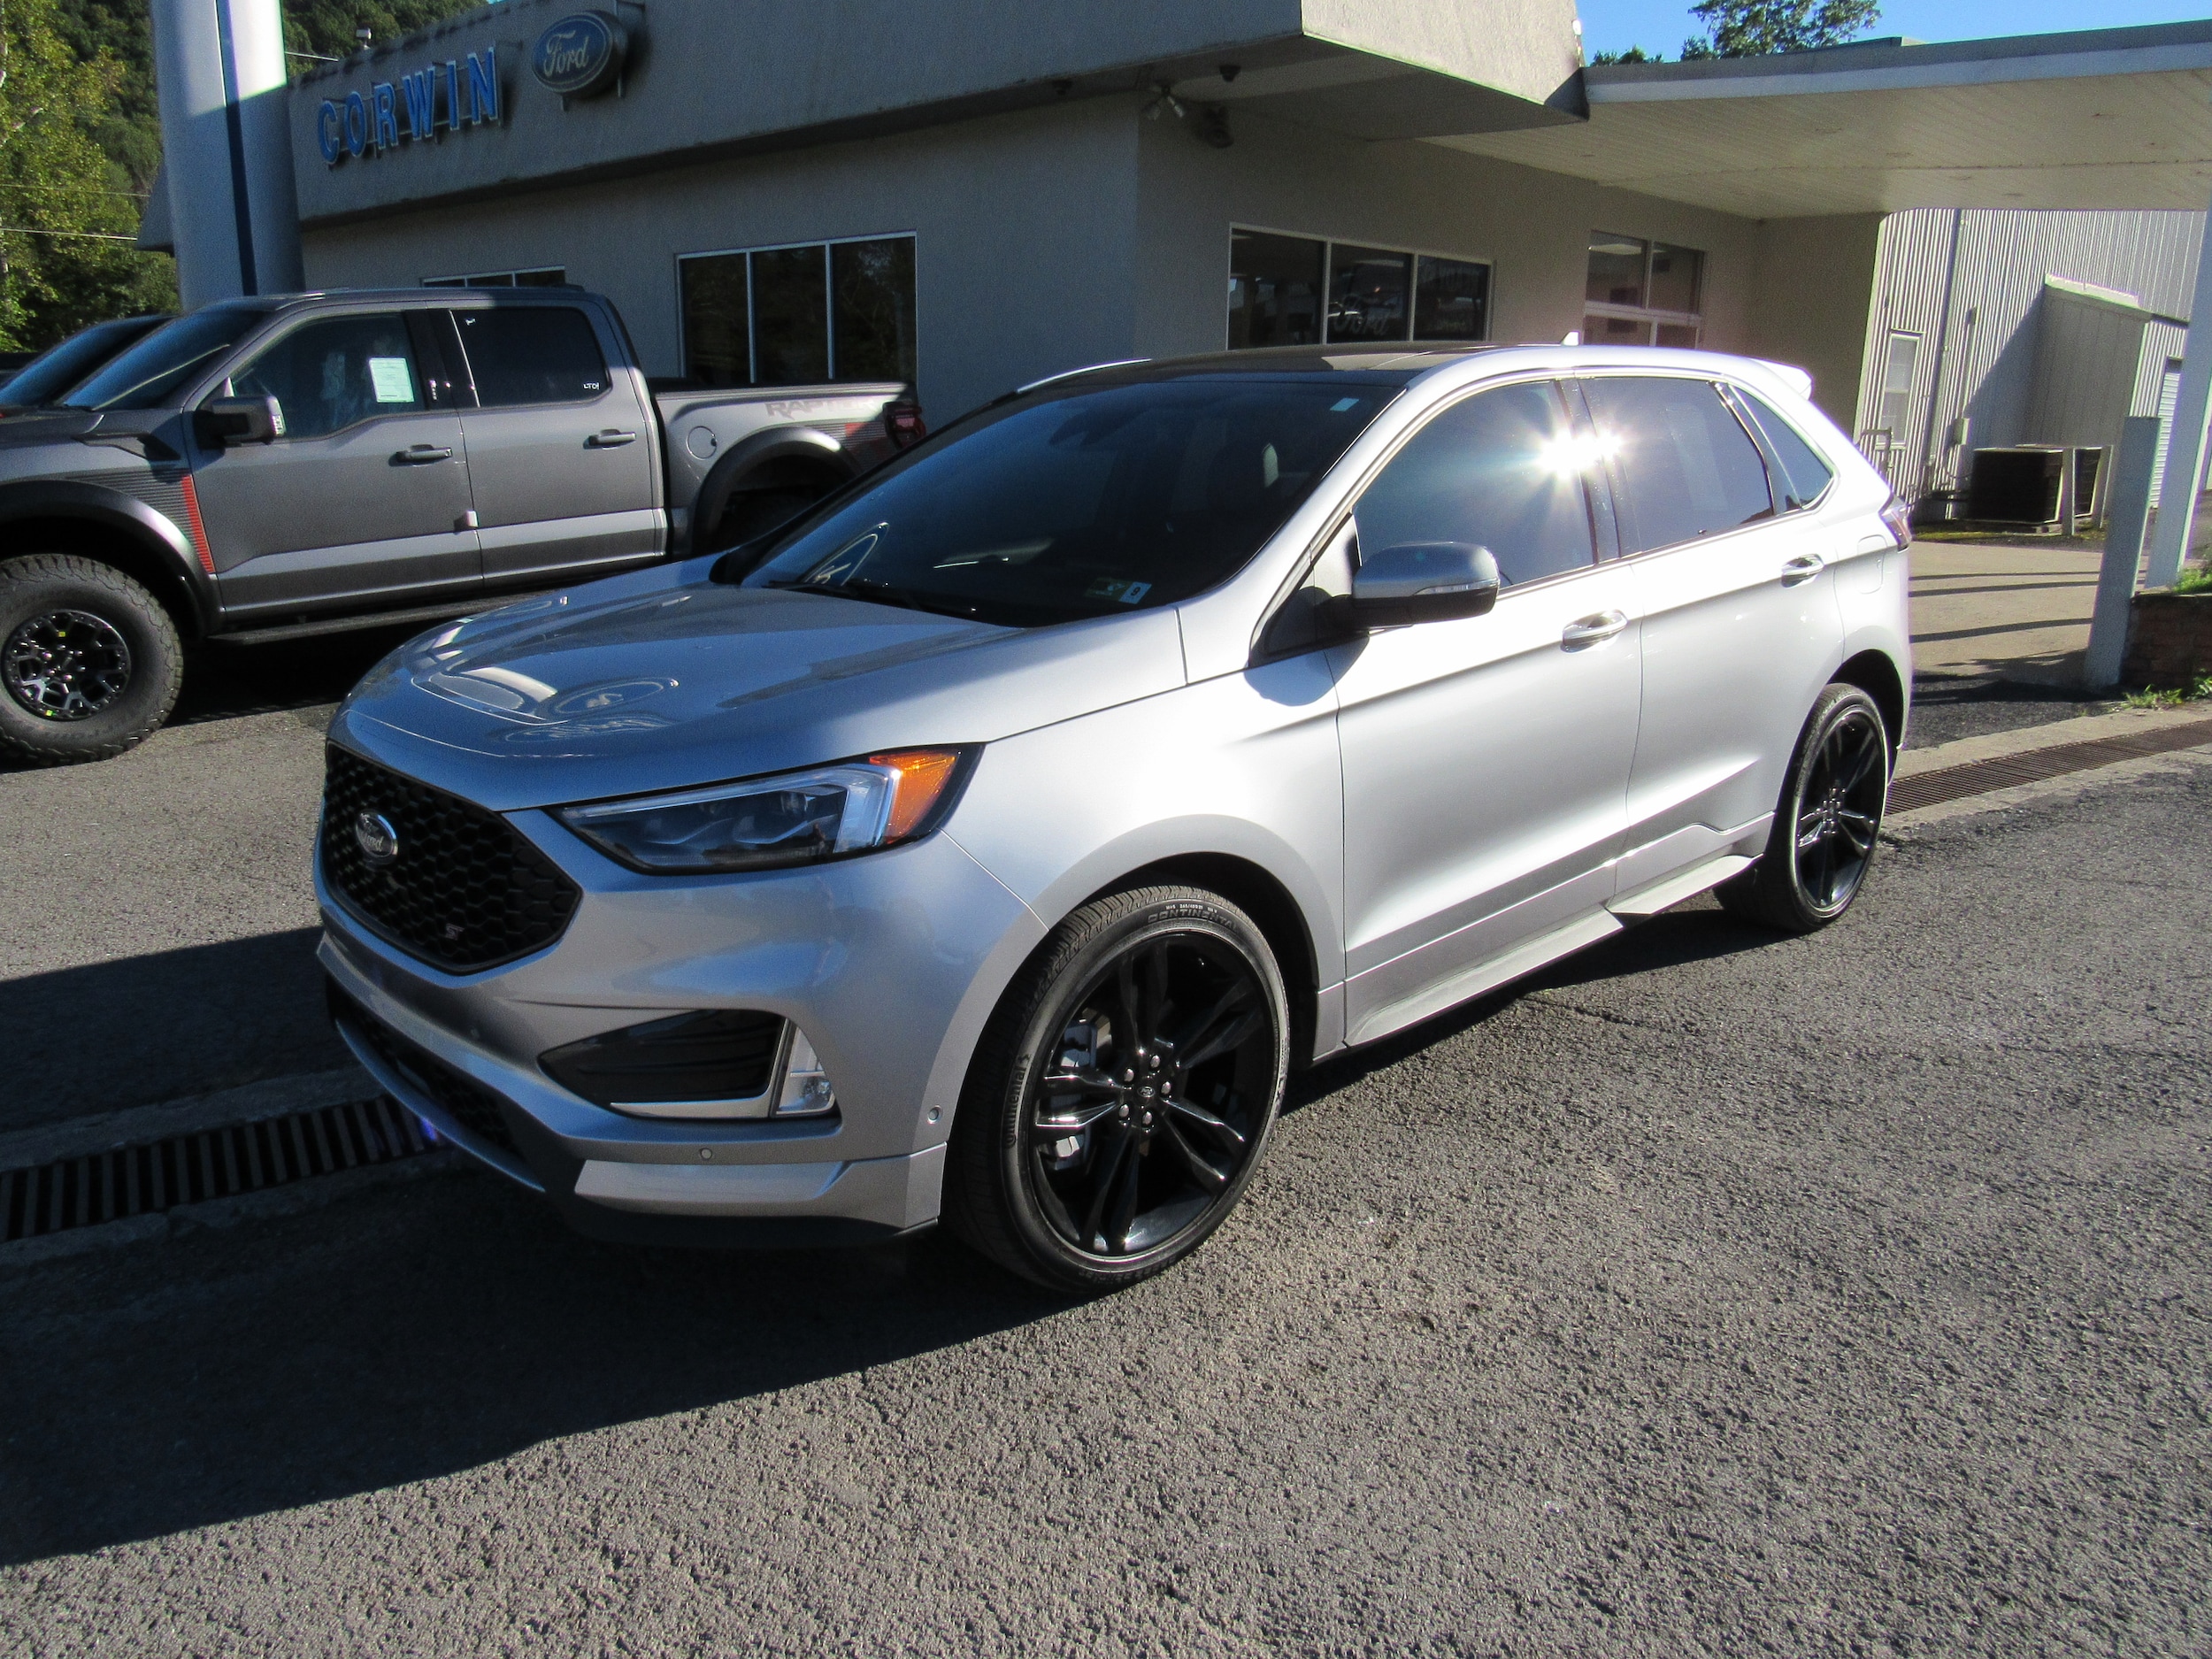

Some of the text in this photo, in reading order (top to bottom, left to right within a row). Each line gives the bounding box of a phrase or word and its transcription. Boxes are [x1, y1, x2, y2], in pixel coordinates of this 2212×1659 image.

[543, 29, 590, 78] Ford
[318, 47, 498, 165] CORWIN
[445, 923, 465, 941] ST
